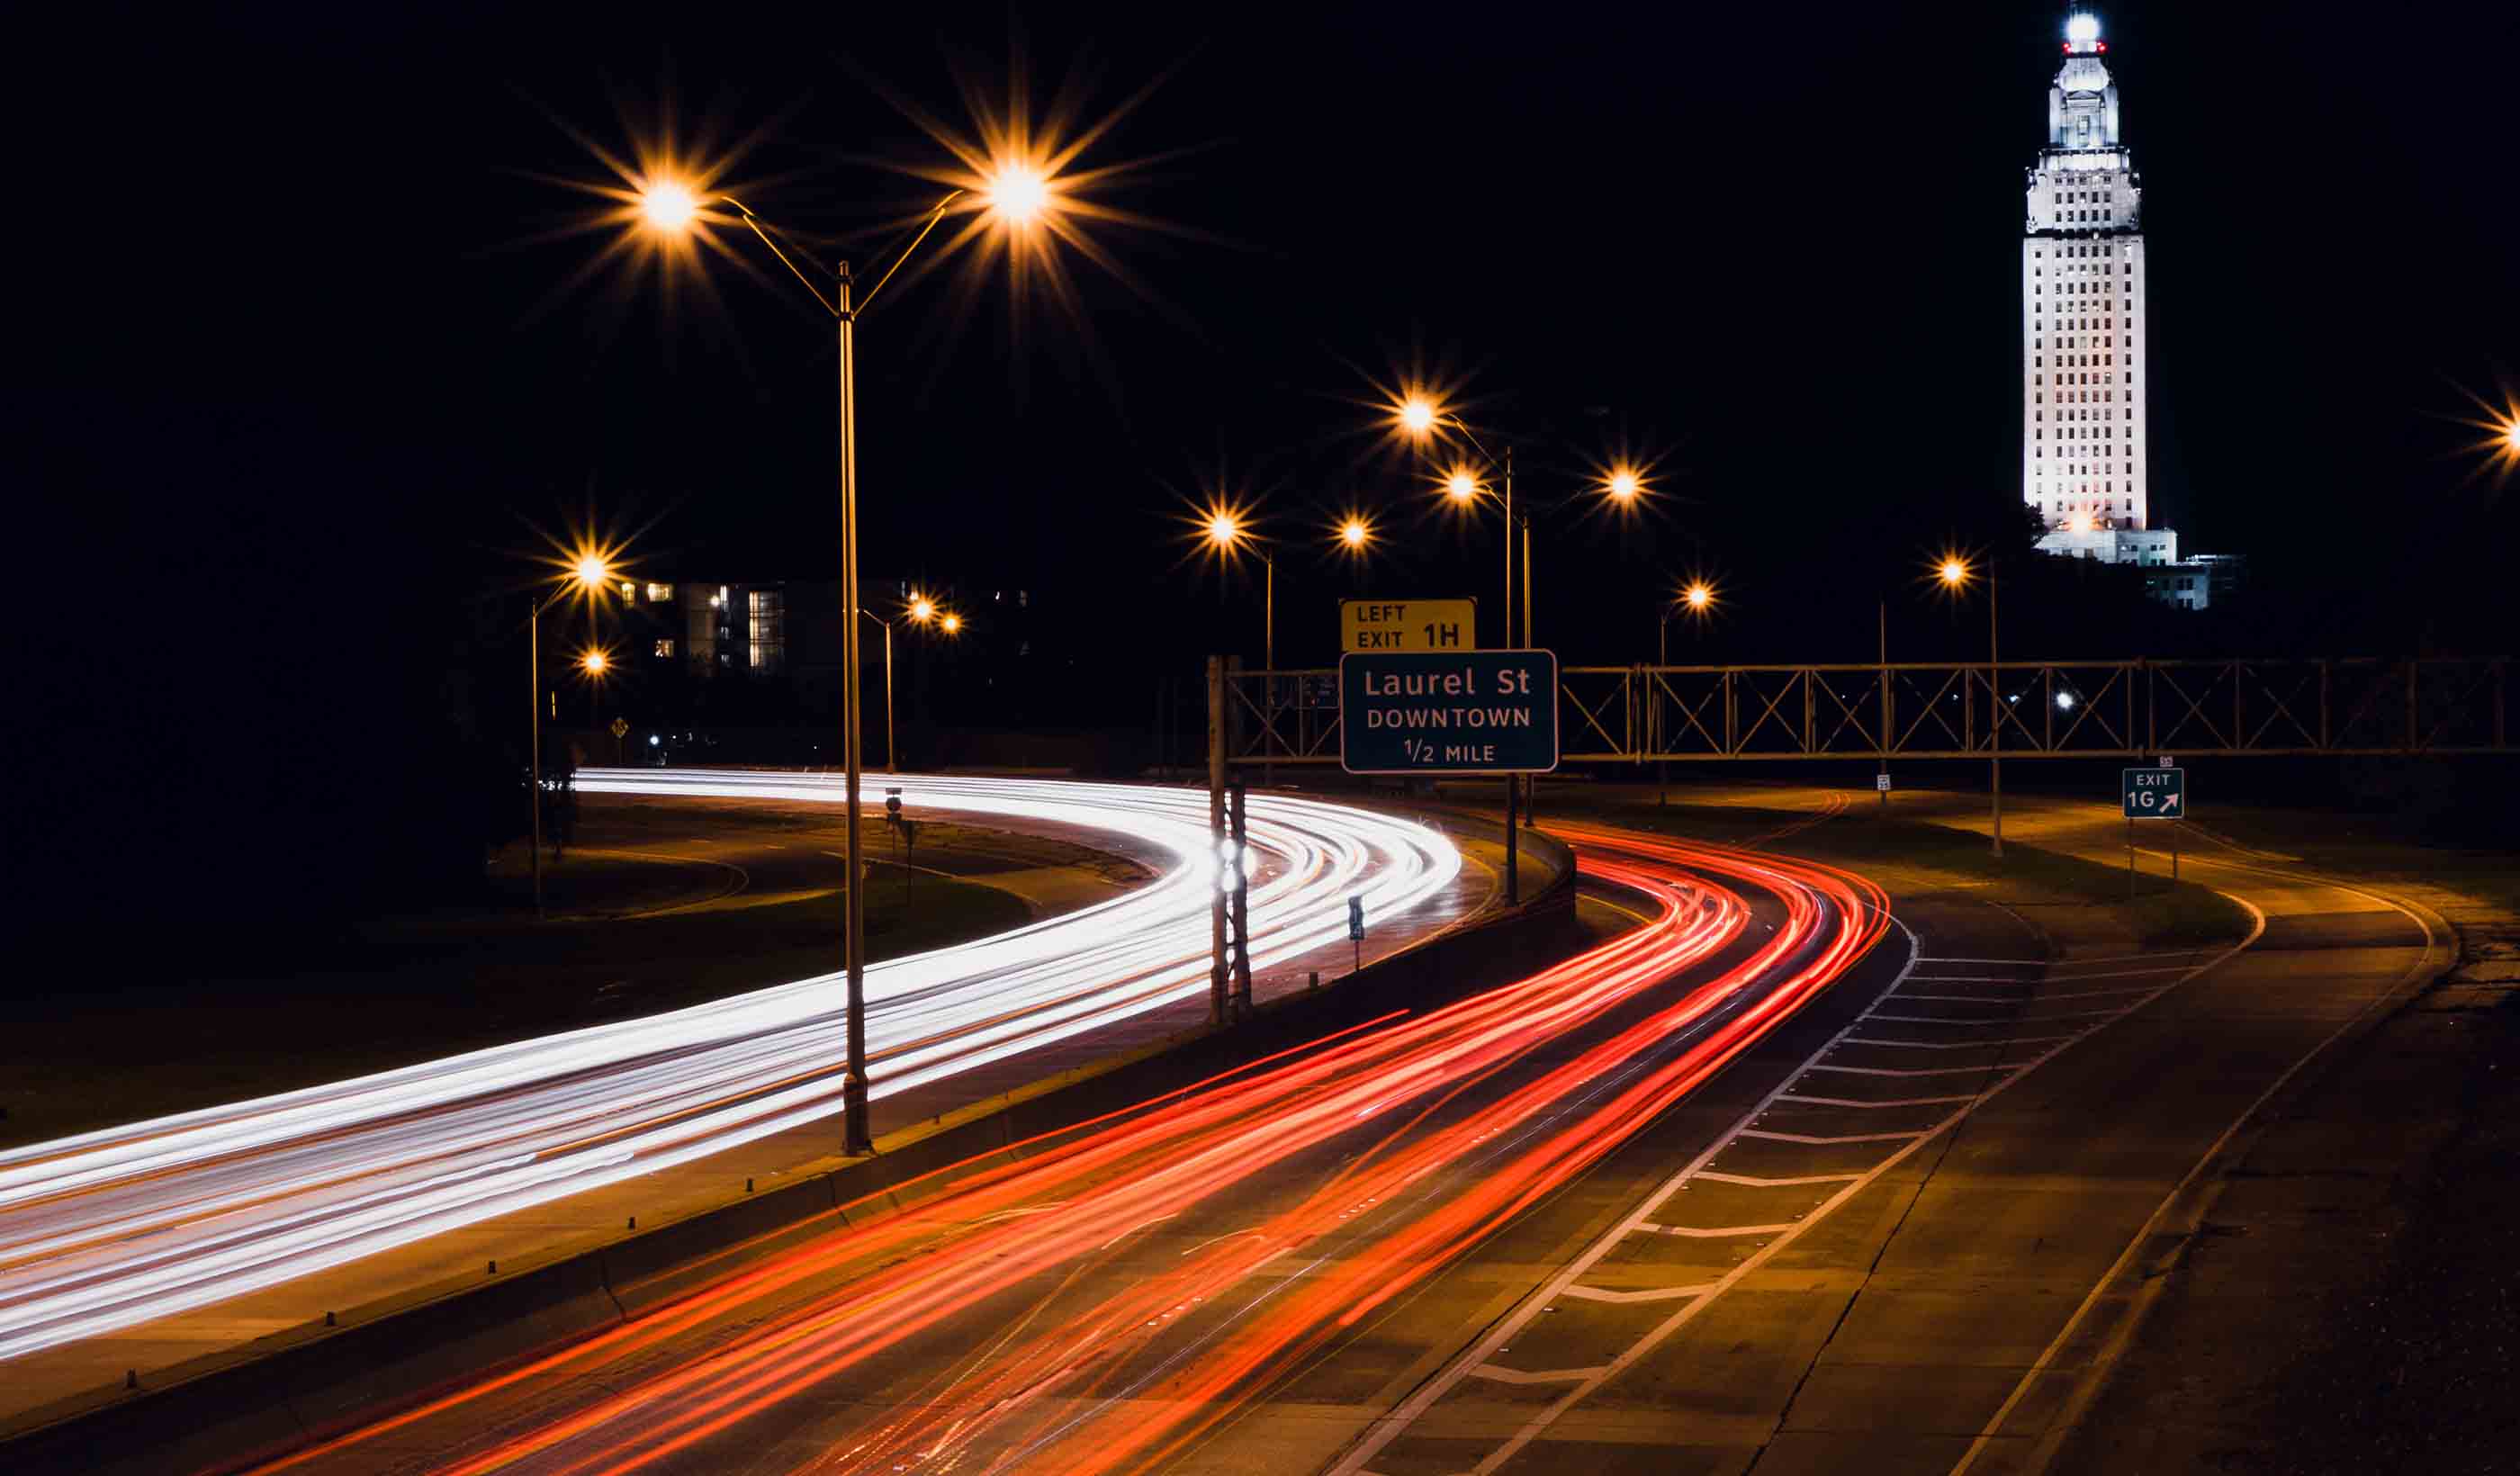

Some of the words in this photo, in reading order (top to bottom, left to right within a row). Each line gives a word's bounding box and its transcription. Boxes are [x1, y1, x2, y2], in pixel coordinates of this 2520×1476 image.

[1357, 605, 1406, 622] LEFT
[1357, 631, 1404, 648] EXIT
[1424, 623, 1460, 647] 1H
[1365, 666, 1476, 696] Laurel
[1497, 668, 1530, 695] St
[1367, 707, 1531, 728] DOWNTOWN
[1404, 738, 1434, 762] 1/2
[1445, 745, 1497, 762] MILE
[2136, 774, 2172, 786] EXIT
[2128, 791, 2155, 807] 1G
